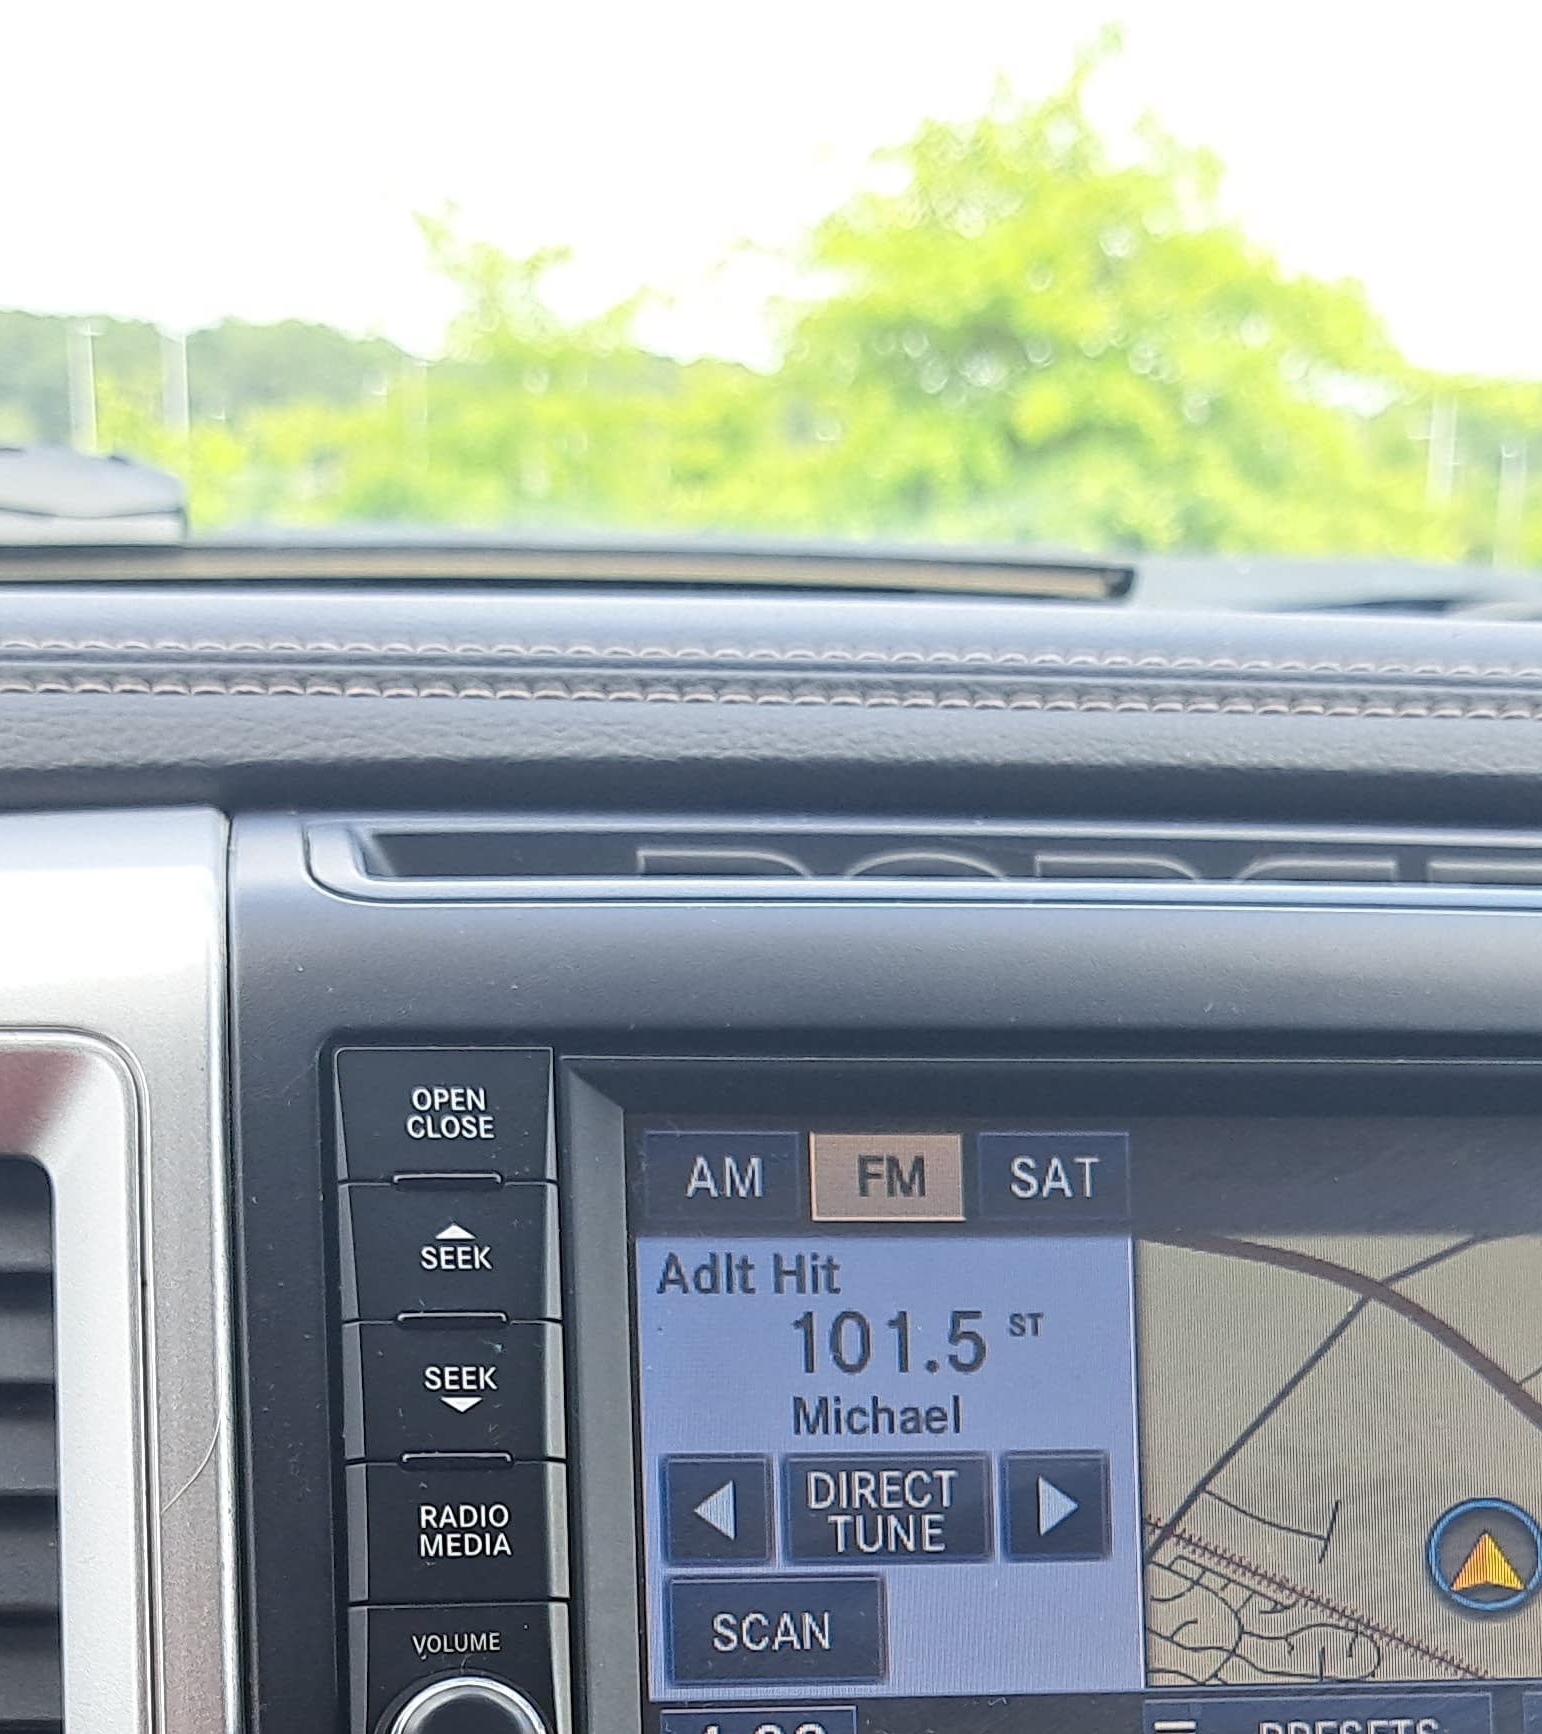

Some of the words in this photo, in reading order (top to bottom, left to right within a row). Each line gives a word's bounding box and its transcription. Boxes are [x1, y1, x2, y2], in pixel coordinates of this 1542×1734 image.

[411, 1085, 487, 1114] OPEN
[405, 1112, 495, 1141] CLOSE
[685, 1155, 765, 1200] AM
[856, 1154, 929, 1199] FM
[1008, 1155, 1100, 1200] SAT
[419, 1243, 493, 1272] SEEK
[657, 1250, 757, 1297] Adlt
[771, 1250, 843, 1297] Hit
[791, 1309, 988, 1376] 101.5
[1008, 1311, 1044, 1339] ST
[423, 1364, 498, 1392] SEEK
[792, 1393, 963, 1437] Michael
[805, 1469, 959, 1511] DIRECT
[419, 1503, 511, 1531] RADIO
[827, 1513, 947, 1555] TUNE
[418, 1530, 513, 1559] MEDIA
[412, 1631, 503, 1655] VOLUME
[710, 1610, 832, 1654] SCAN
